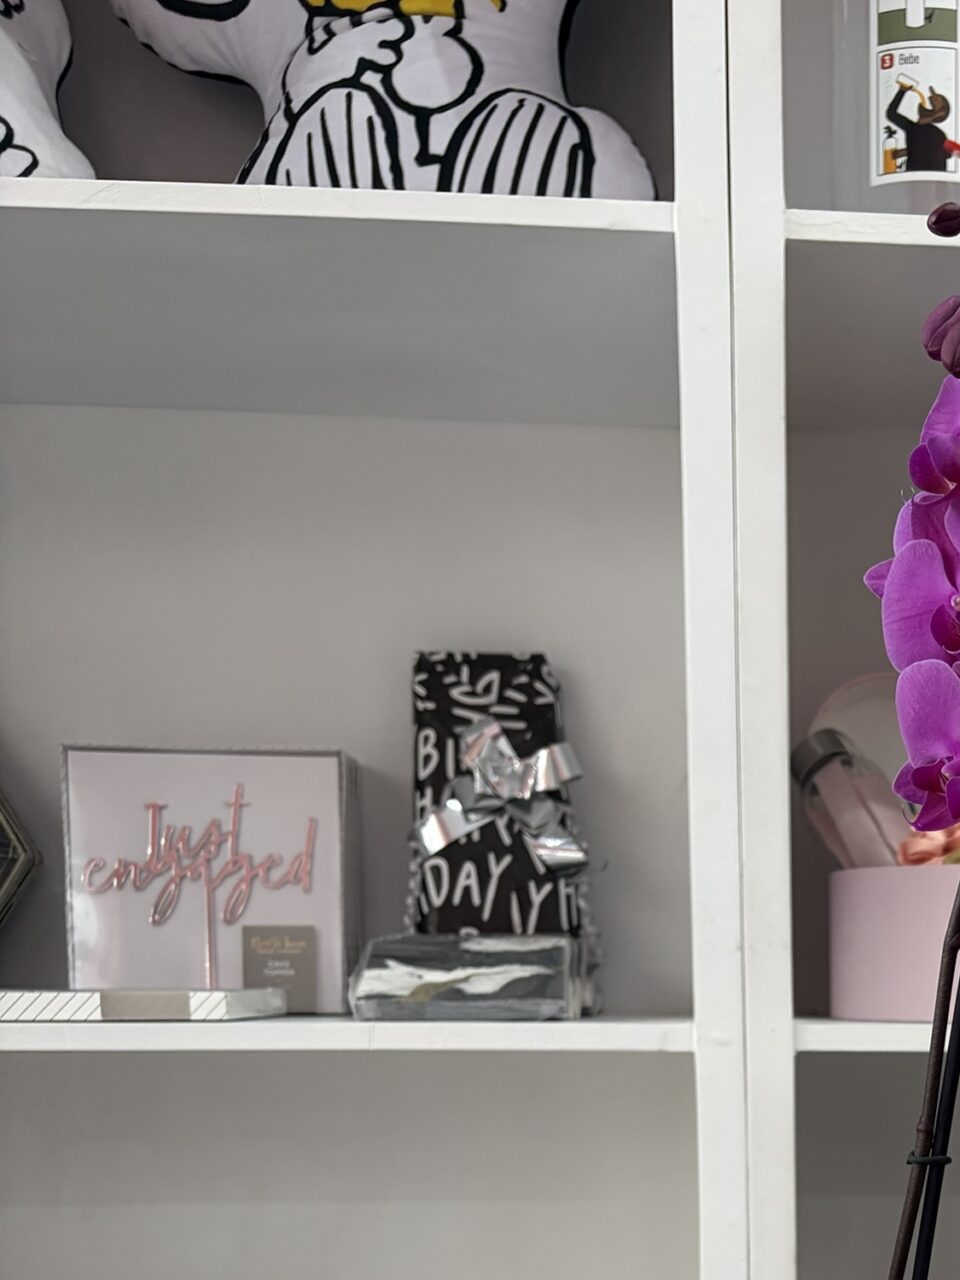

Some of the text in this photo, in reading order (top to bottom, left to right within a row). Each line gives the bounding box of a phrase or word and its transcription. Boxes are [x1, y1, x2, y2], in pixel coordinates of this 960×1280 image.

[81, 816, 319, 926] engaged
[144, 782, 250, 873] Just
[423, 853, 513, 922] DAY
